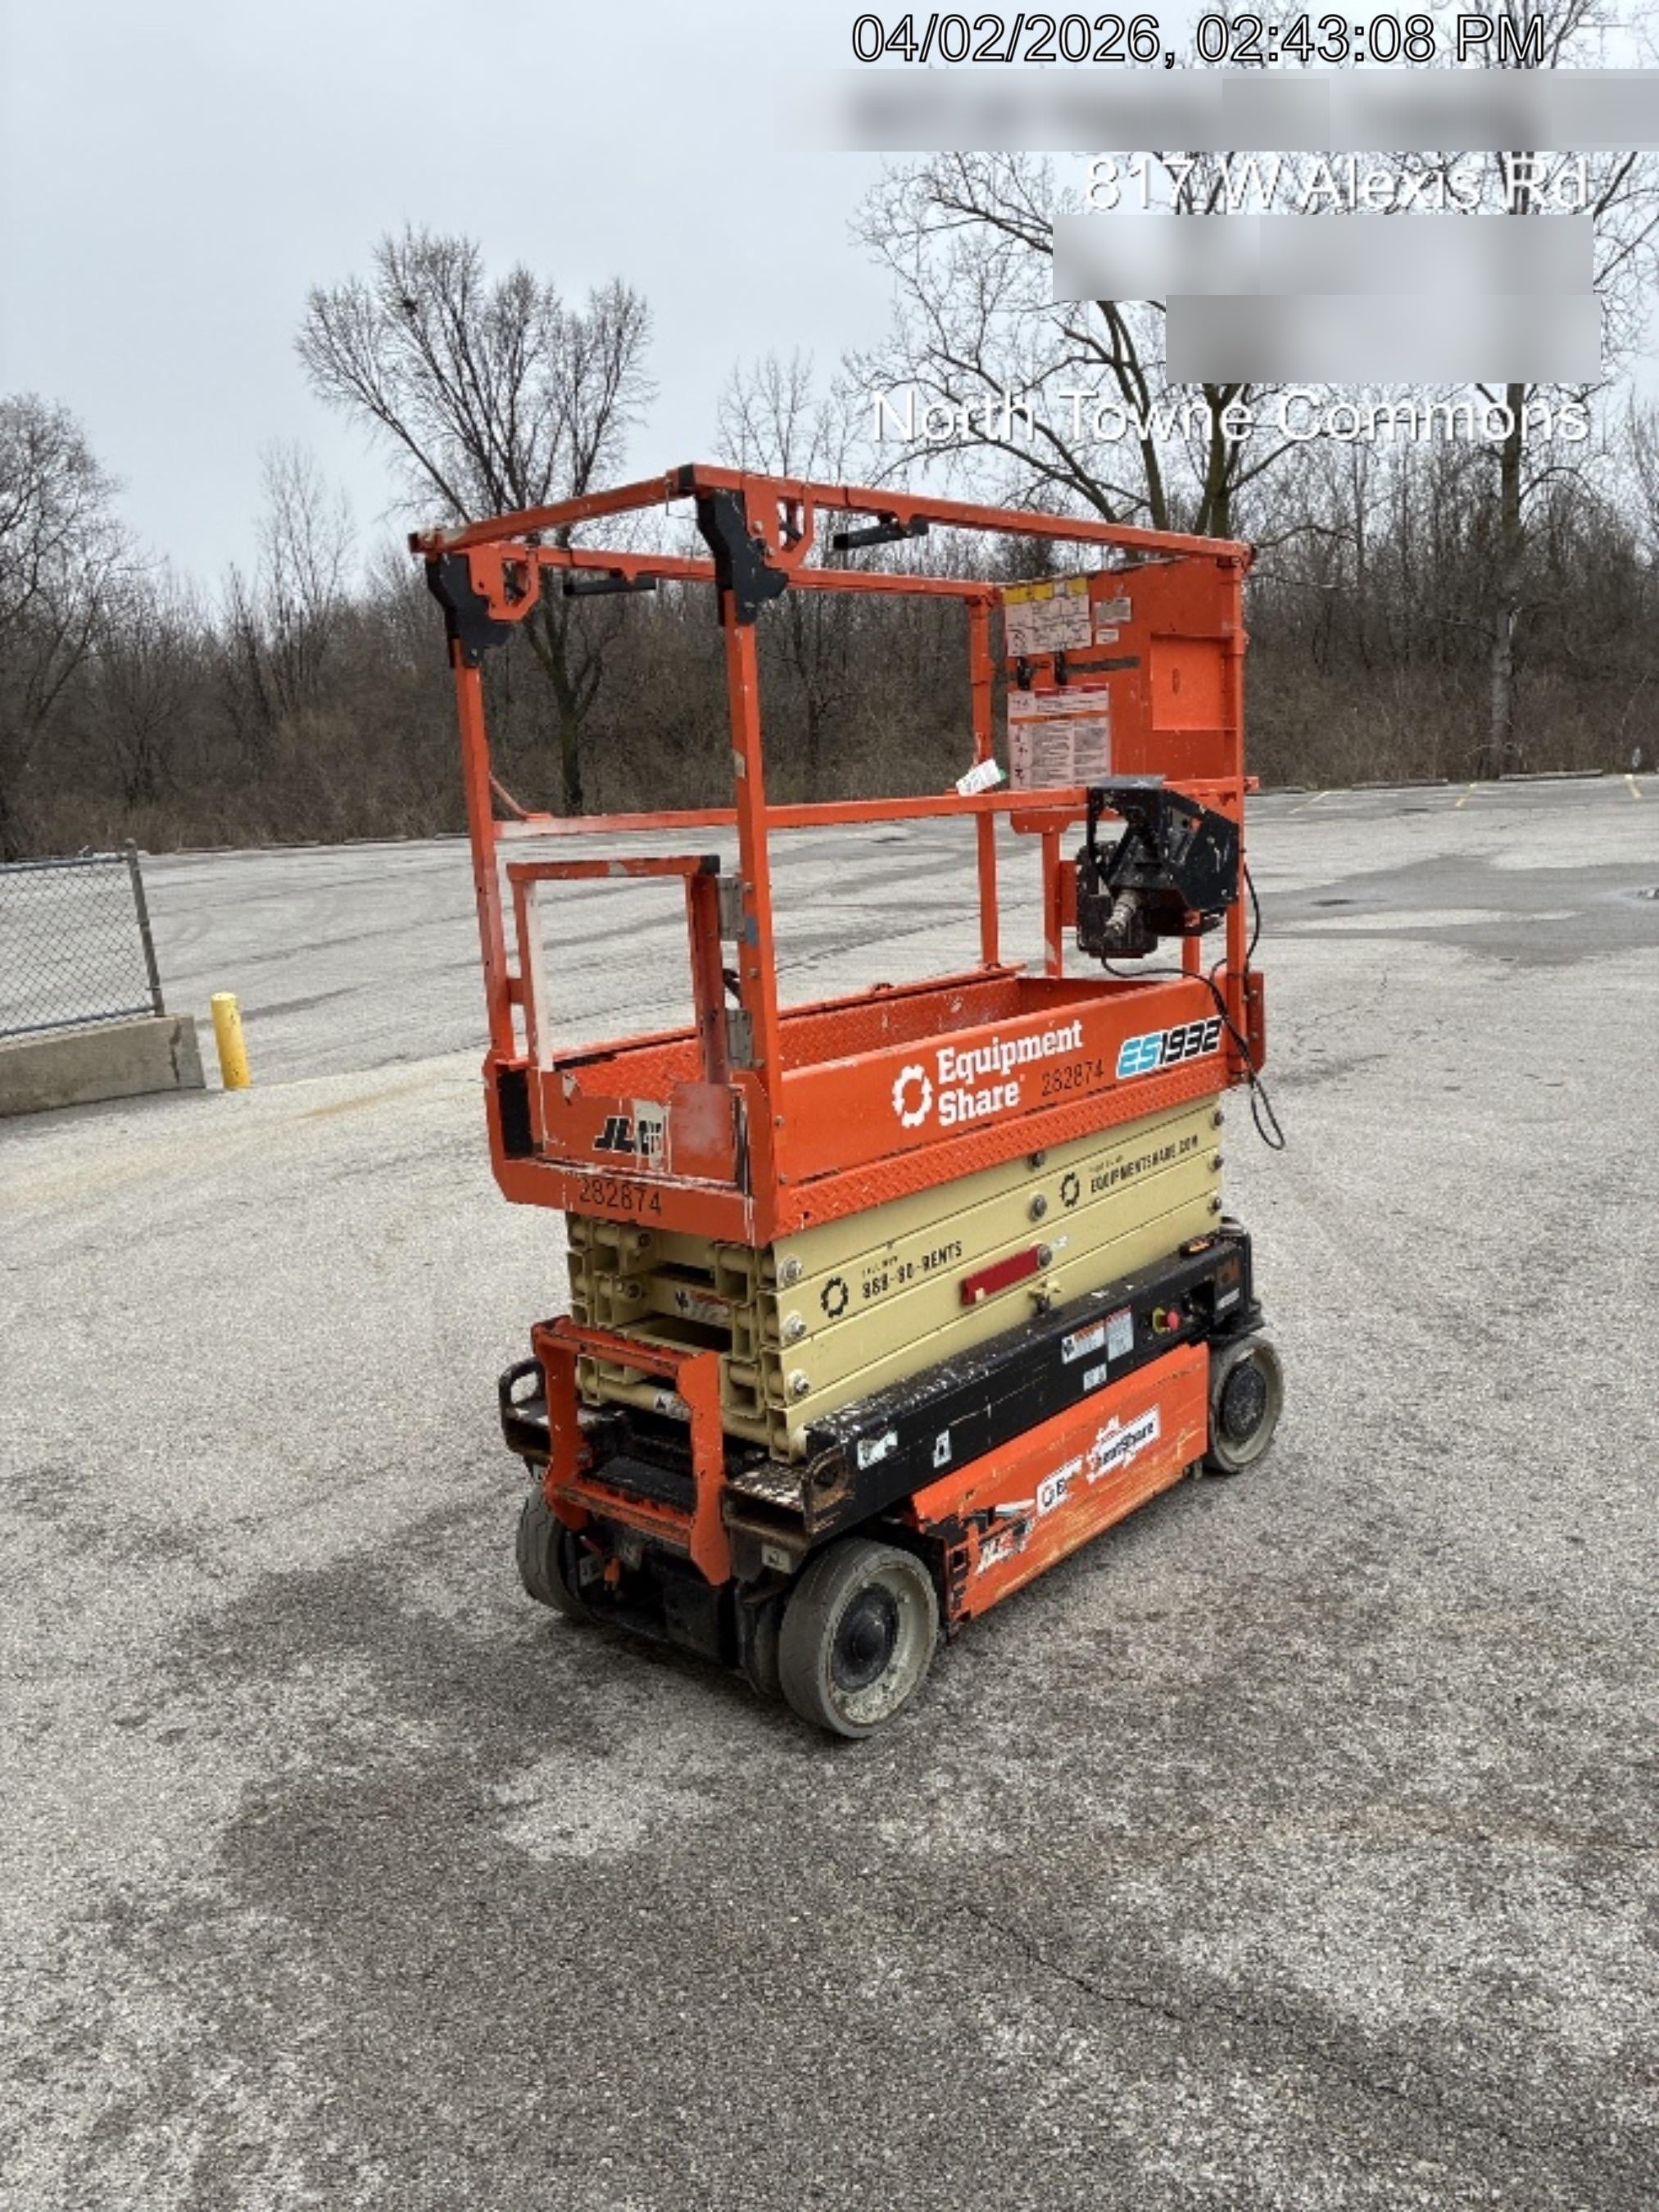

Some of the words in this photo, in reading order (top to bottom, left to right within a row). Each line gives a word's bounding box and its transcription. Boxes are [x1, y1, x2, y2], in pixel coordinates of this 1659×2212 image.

[936, 1019, 1083, 1085] Equipment
[1117, 1016, 1222, 1079] ES1932
[938, 1080, 1019, 1127] Share
